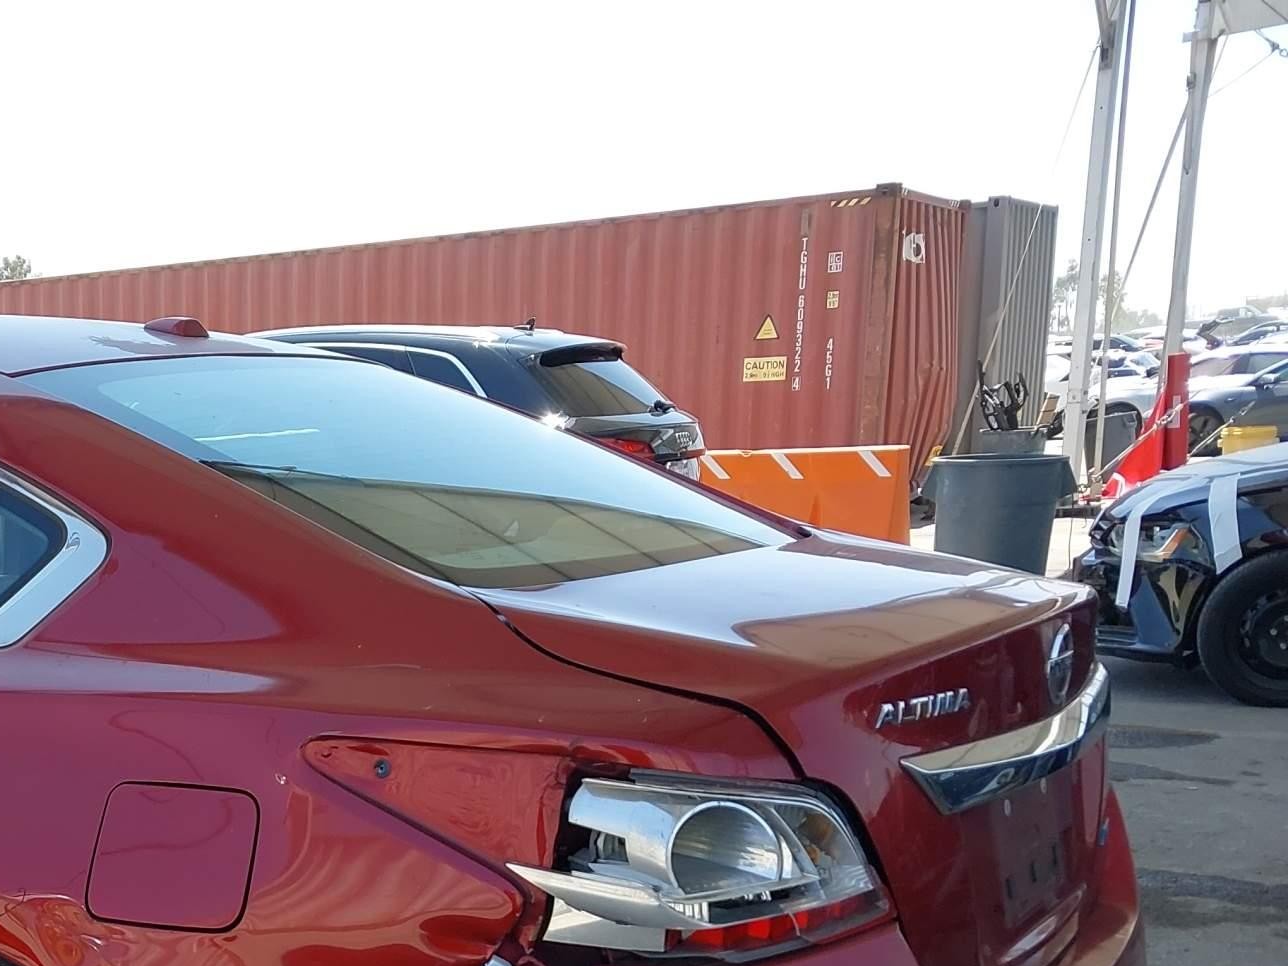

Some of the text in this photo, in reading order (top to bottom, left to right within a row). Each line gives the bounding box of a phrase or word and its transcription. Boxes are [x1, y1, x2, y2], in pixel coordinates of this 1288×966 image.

[799, 237, 809, 289] TGHU
[794, 295, 804, 373] 609322
[745, 360, 785, 371] CAUTION
[825, 337, 834, 390] 45G1
[874, 687, 972, 729] ALTIMA
